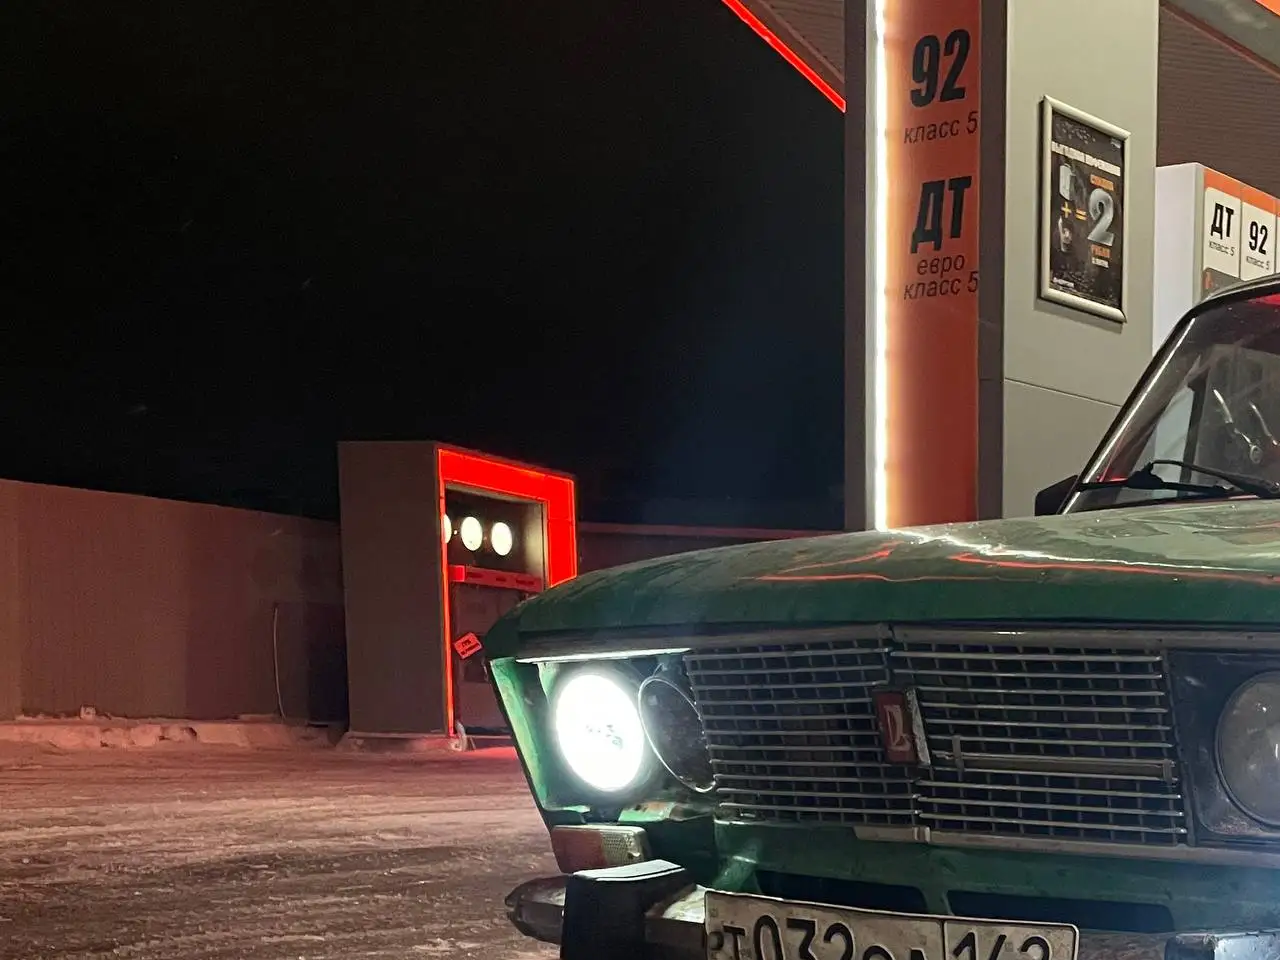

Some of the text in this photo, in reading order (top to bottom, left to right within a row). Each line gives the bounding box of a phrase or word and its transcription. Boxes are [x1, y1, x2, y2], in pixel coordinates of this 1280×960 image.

[910, 29, 971, 107] 92
[903, 110, 979, 144] класс 5
[911, 176, 972, 254] ДТ
[1088, 188, 1114, 246] 2
[1210, 202, 1235, 240] ДТ
[1248, 221, 1268, 255] 92
[916, 254, 965, 276] евро
[903, 271, 979, 300] класс 5
